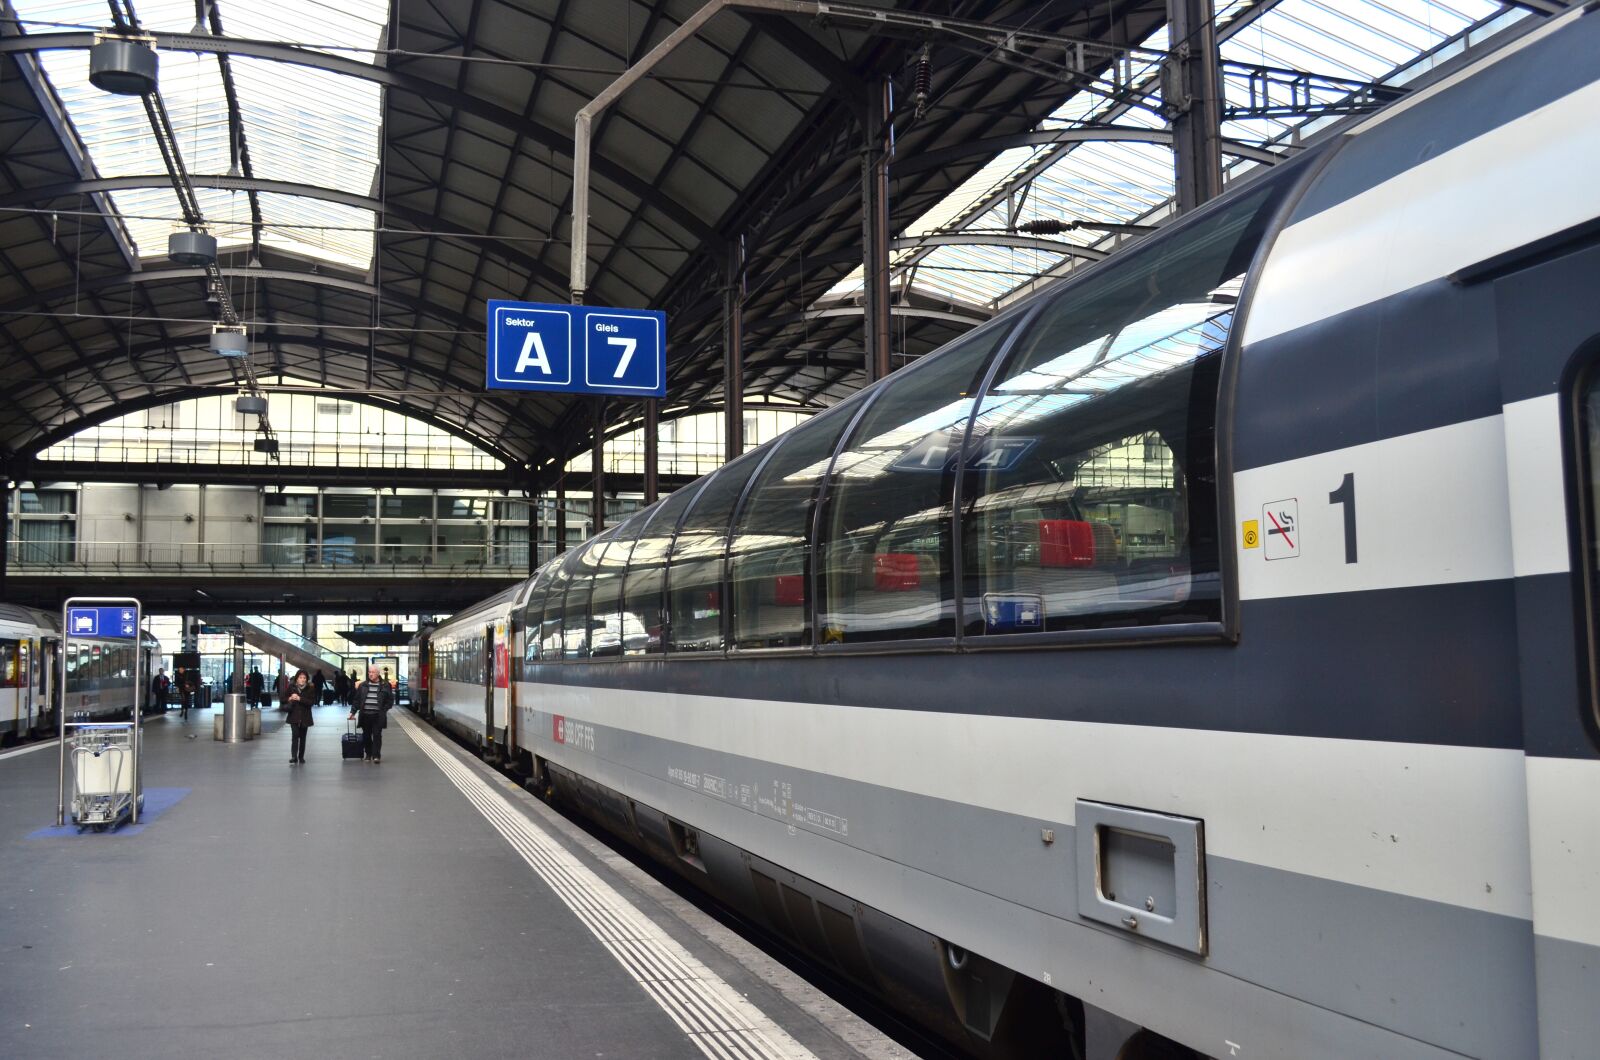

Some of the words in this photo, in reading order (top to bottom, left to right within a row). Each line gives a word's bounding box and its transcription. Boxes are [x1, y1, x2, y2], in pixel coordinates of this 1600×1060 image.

[505, 317, 535, 327] Sektor
[595, 323, 619, 333] Gleis
[514, 332, 552, 374] A
[607, 336, 637, 378] 7
[1044, 524, 1049, 535] 1
[1329, 472, 1358, 564] 1
[565, 720, 575, 744] SBB
[575, 722, 584, 748] CFF
[584, 725, 595, 752] FFS
